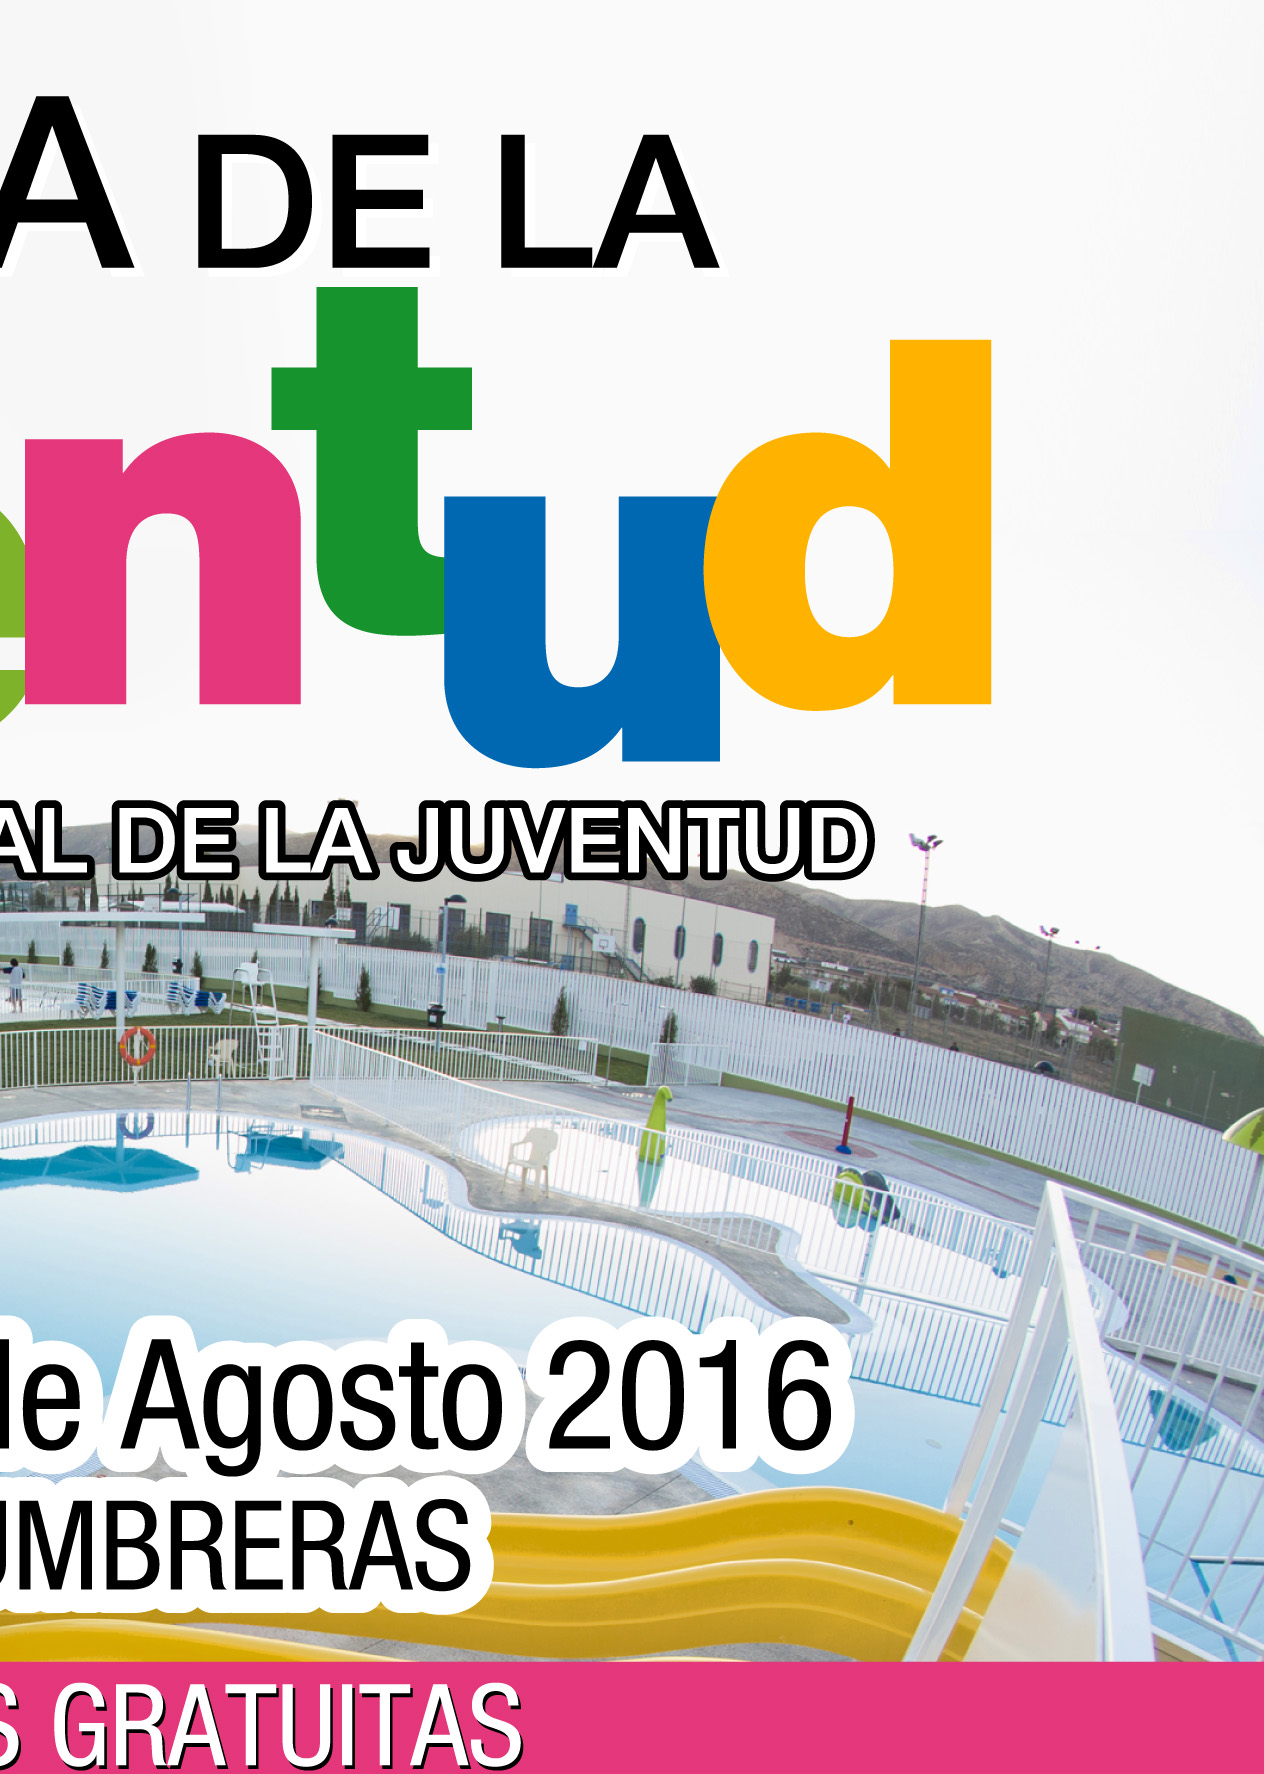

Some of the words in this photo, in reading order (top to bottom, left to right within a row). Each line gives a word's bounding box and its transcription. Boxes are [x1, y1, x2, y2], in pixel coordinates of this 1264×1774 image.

[199, 135, 429, 267] DE
[501, 135, 719, 267] LA
[120, 808, 231, 872] DE
[267, 808, 372, 872] LA
[398, 808, 867, 874] JUVENTUD
[121, 1340, 502, 1476] Agosto
[549, 1340, 831, 1450] 2016
[55, 1683, 520, 1766] GRATUITAS
